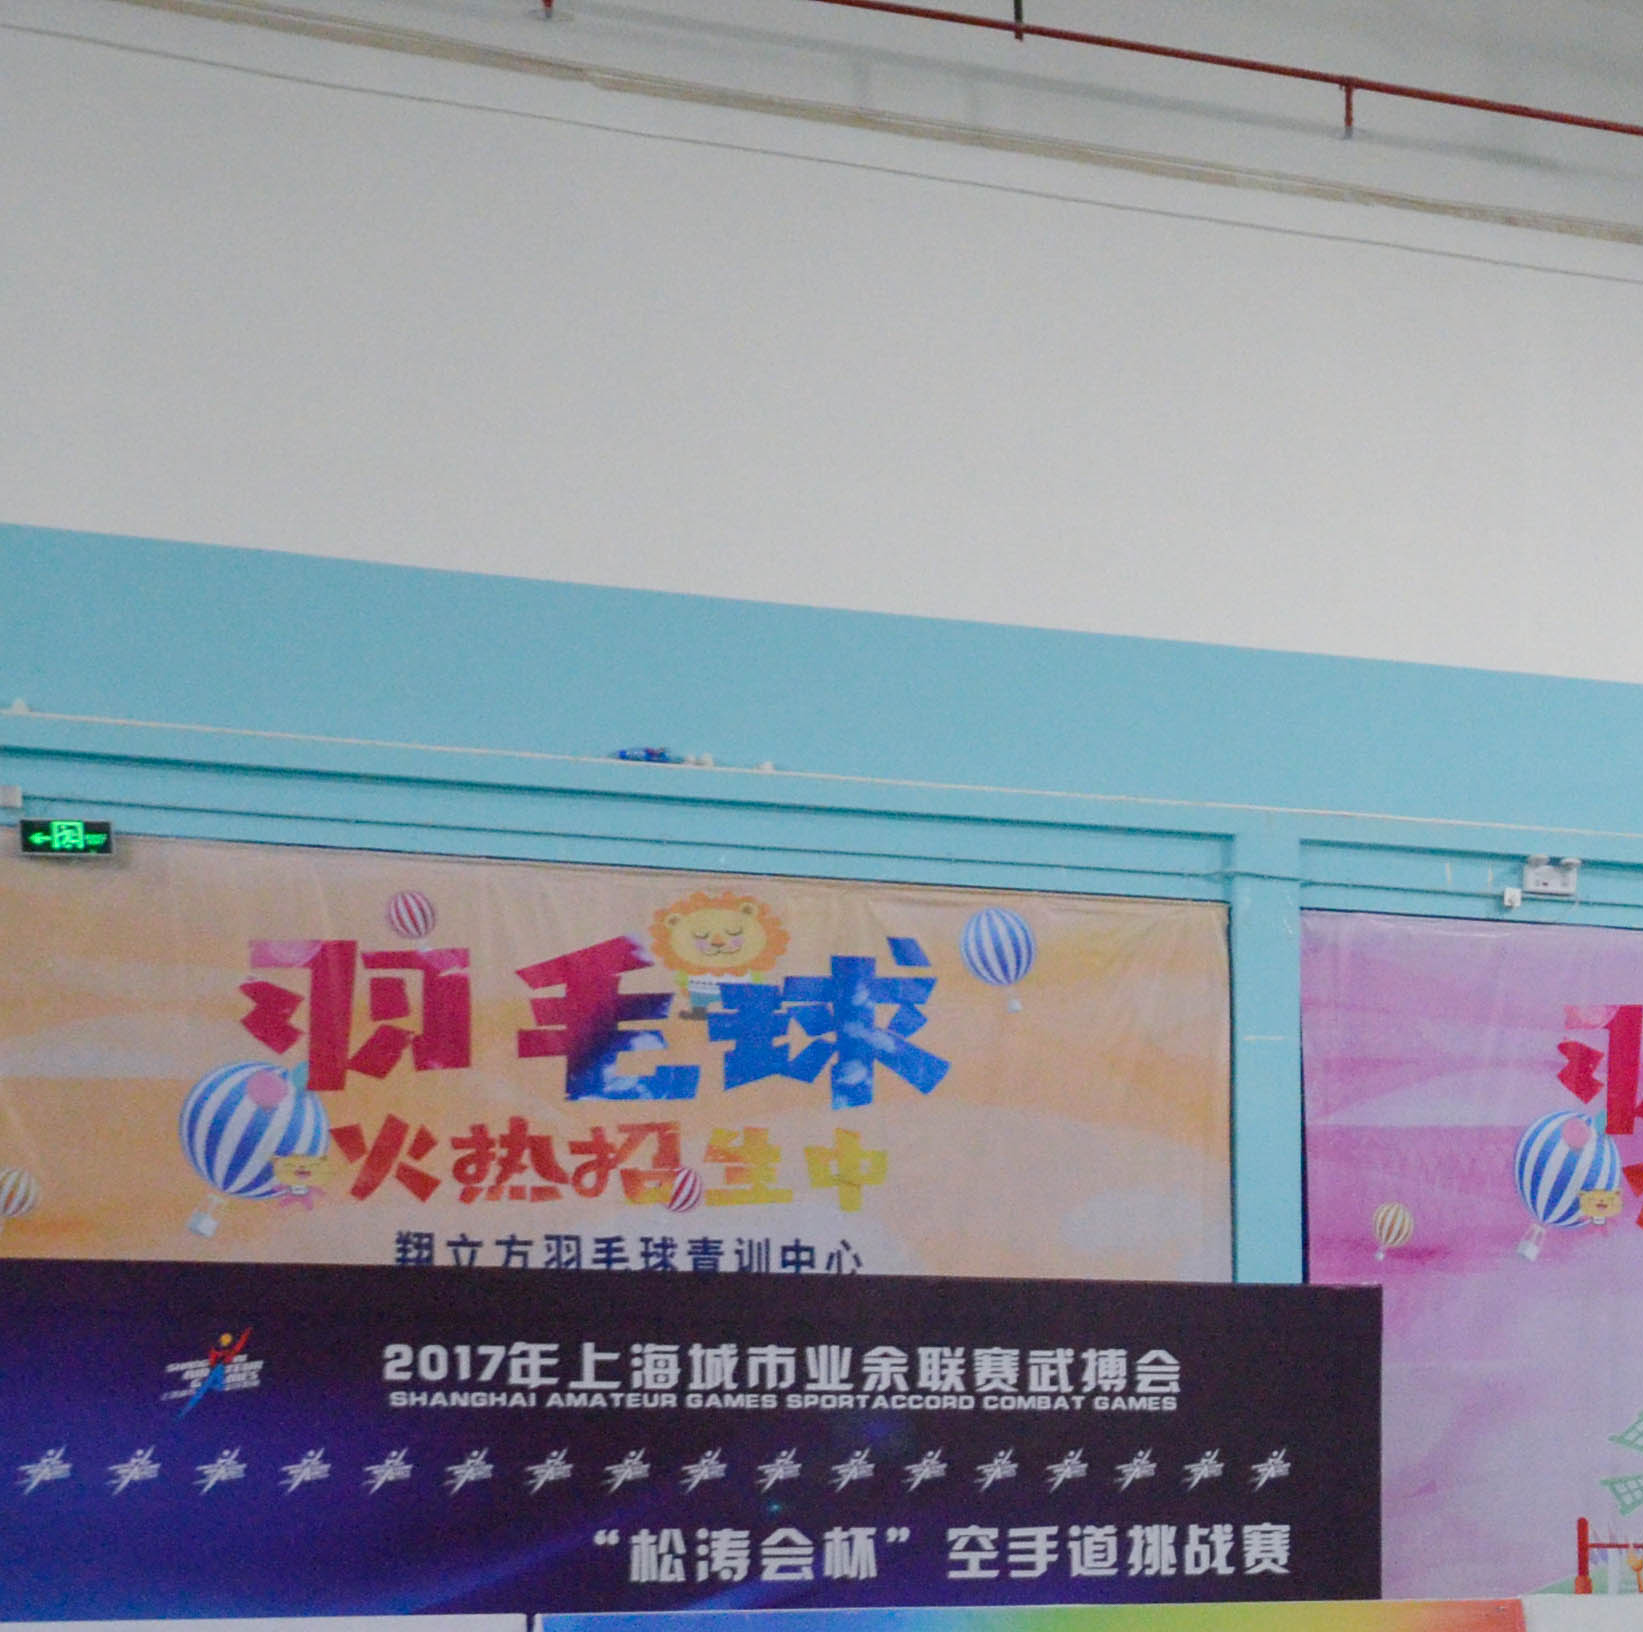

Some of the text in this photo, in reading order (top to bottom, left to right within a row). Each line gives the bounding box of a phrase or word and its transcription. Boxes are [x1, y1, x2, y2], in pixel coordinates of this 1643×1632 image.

[241, 935, 951, 1110] 羽毛球
[330, 1113, 890, 1212] 火热招生中
[395, 1229, 864, 1275] 翔立方羽毛球青训中心
[382, 1341, 1182, 1394] 2017年上海城市业余联赛武搏会
[389, 1391, 1178, 1412] SHANGHAI AMATEUR GAMES SPORTACCORD COMBAT GAMES
[946, 1523, 1292, 1579] 空手道挑战赛
